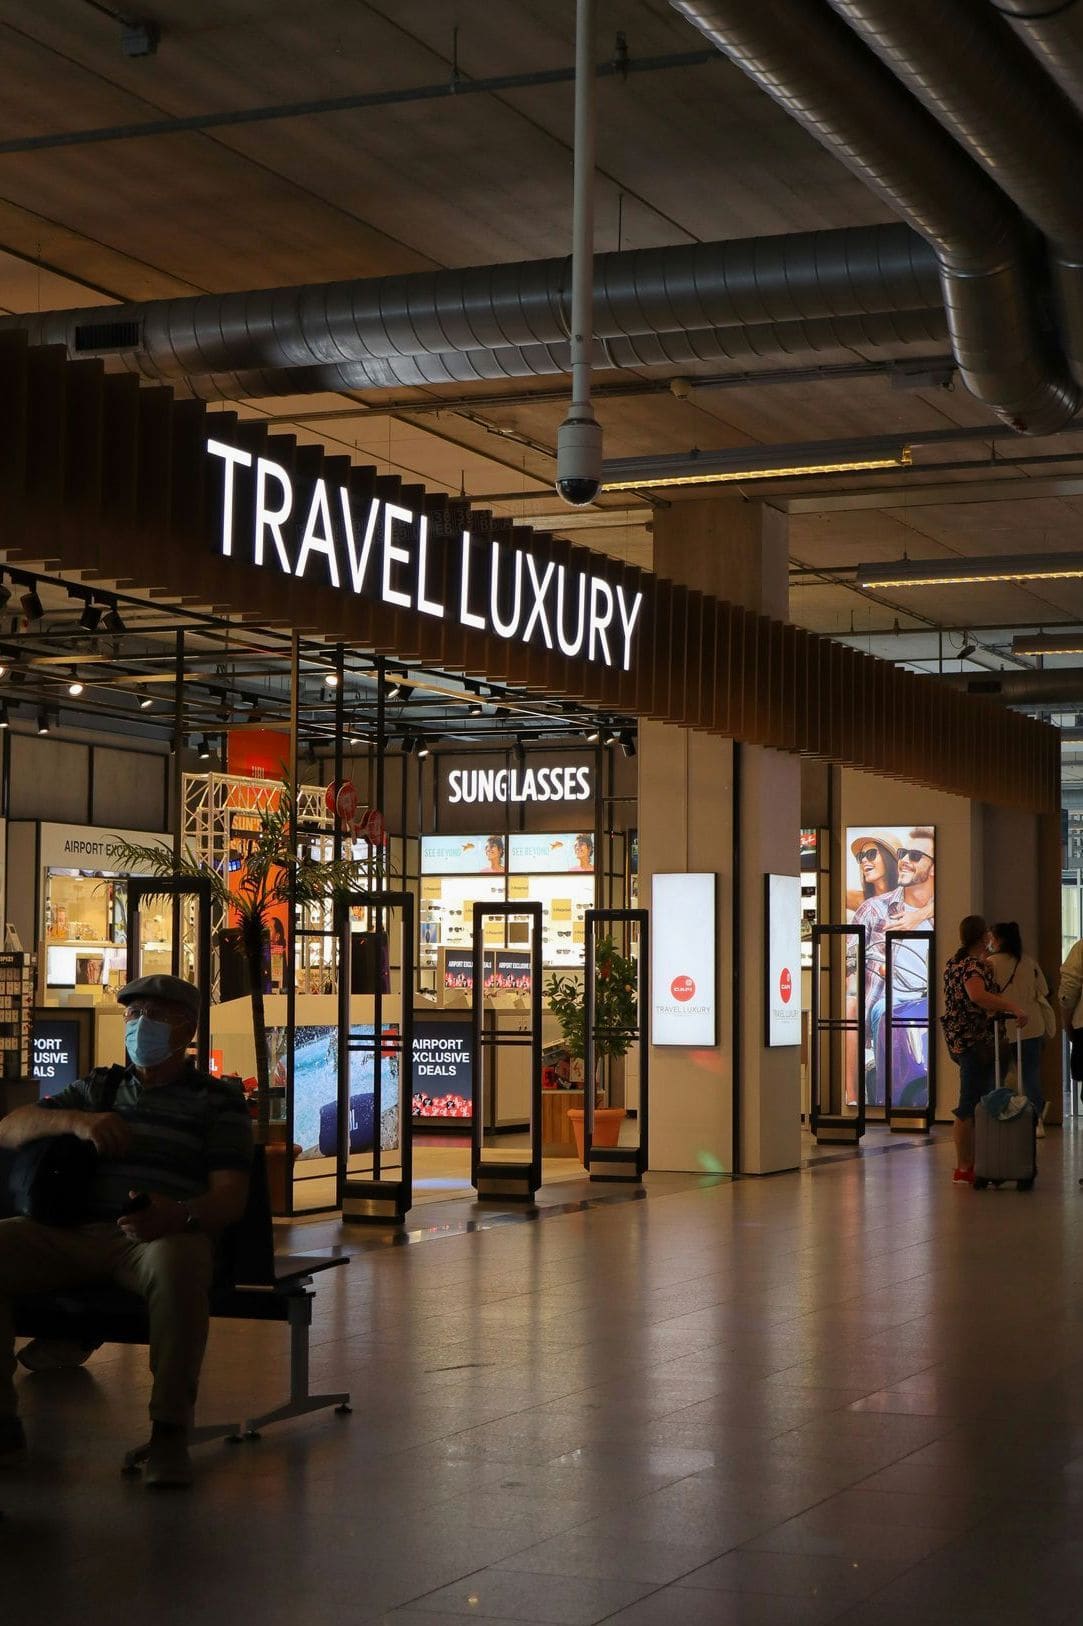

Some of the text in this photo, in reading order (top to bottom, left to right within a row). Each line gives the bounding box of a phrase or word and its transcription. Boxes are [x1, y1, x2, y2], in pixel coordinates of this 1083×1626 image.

[206, 438, 643, 671] TRAVEL LUXURY
[448, 766, 591, 803] SUNGLASSES
[64, 840, 104, 856] AIRPORT
[656, 1005, 711, 1014] TRAVEL LUXURY
[412, 1039, 463, 1050] AIRPORT
[34, 1052, 68, 1064] USIVE
[412, 1052, 470, 1063] XCLUSIVE
[33, 1065, 56, 1078] ALS
[418, 1065, 457, 1076] DEALS
